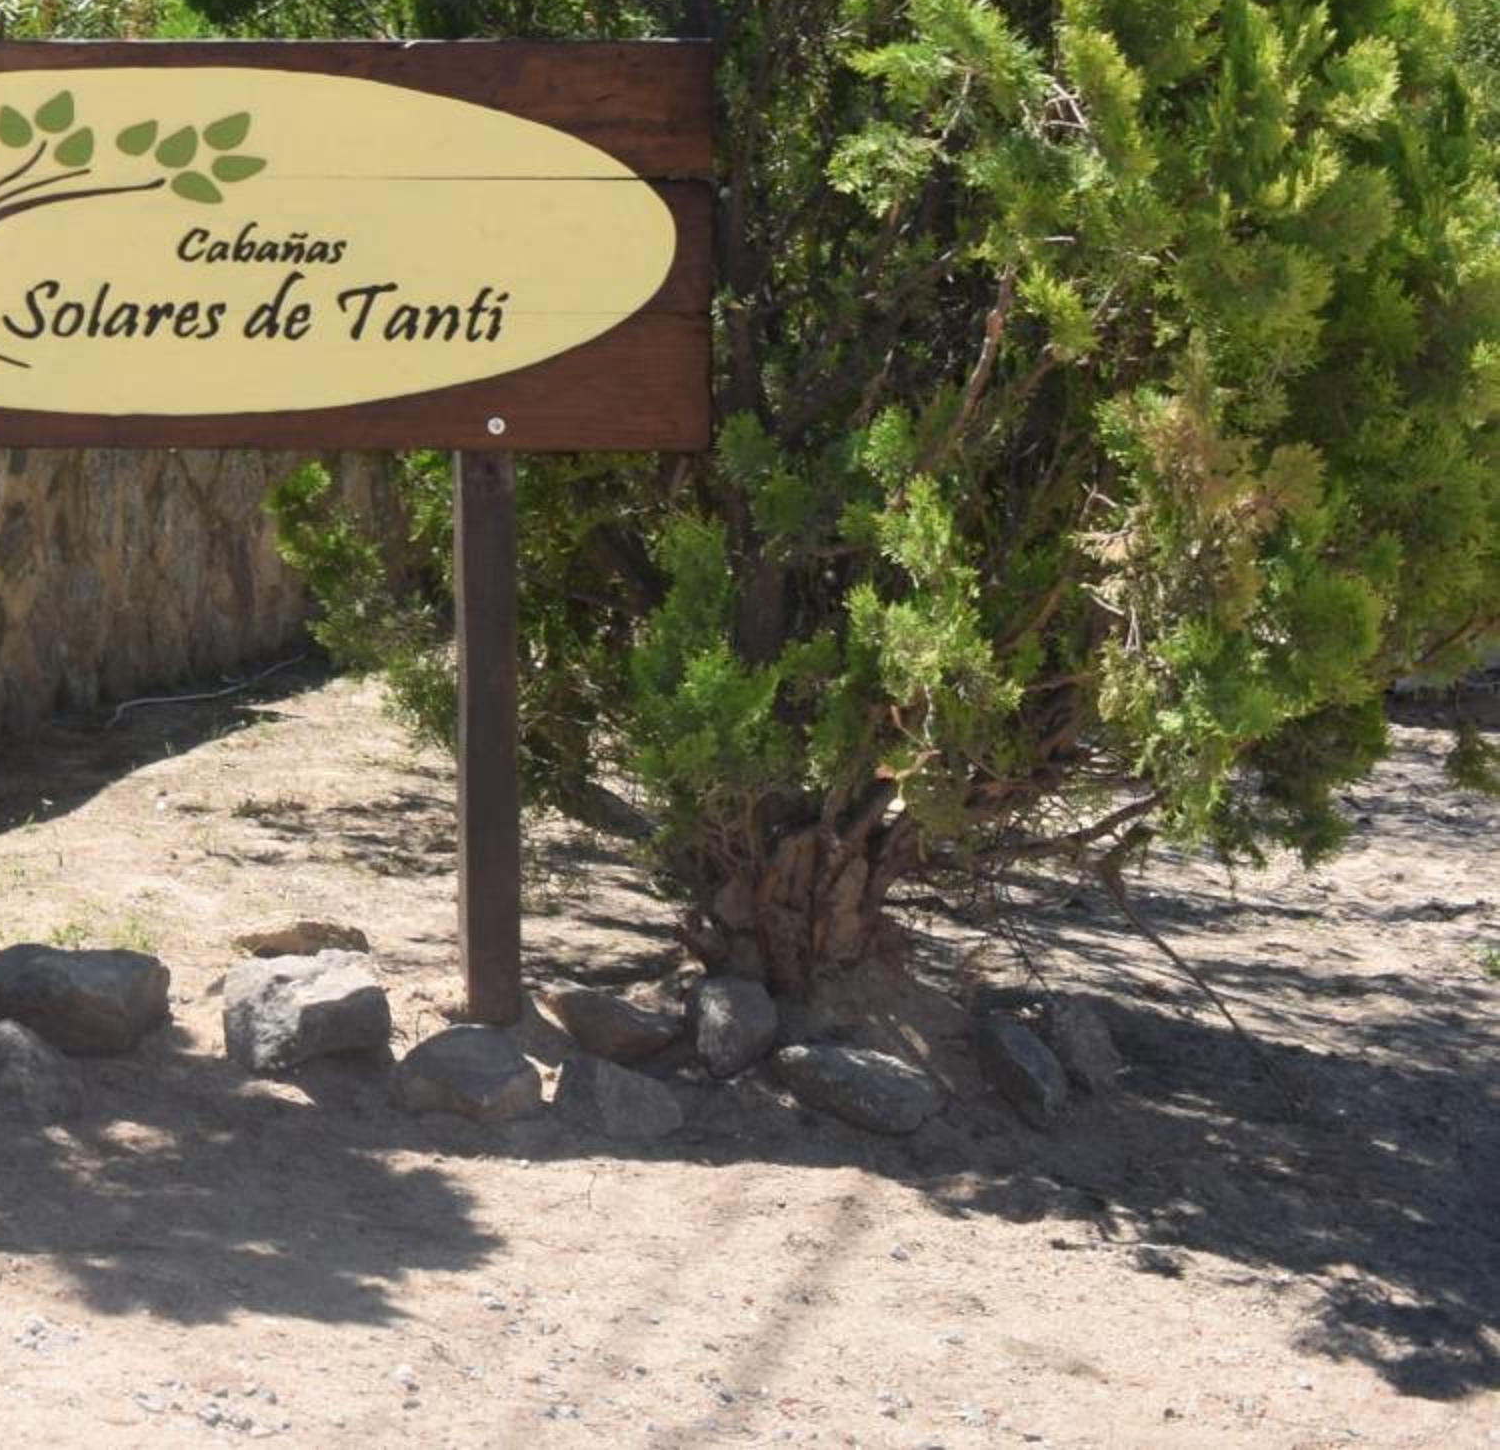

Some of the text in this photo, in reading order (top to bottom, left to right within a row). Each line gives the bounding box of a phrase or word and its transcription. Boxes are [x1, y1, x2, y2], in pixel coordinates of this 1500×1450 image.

[176, 222, 347, 264] Cabañas
[2, 280, 226, 339] Solares
[243, 271, 312, 340] de
